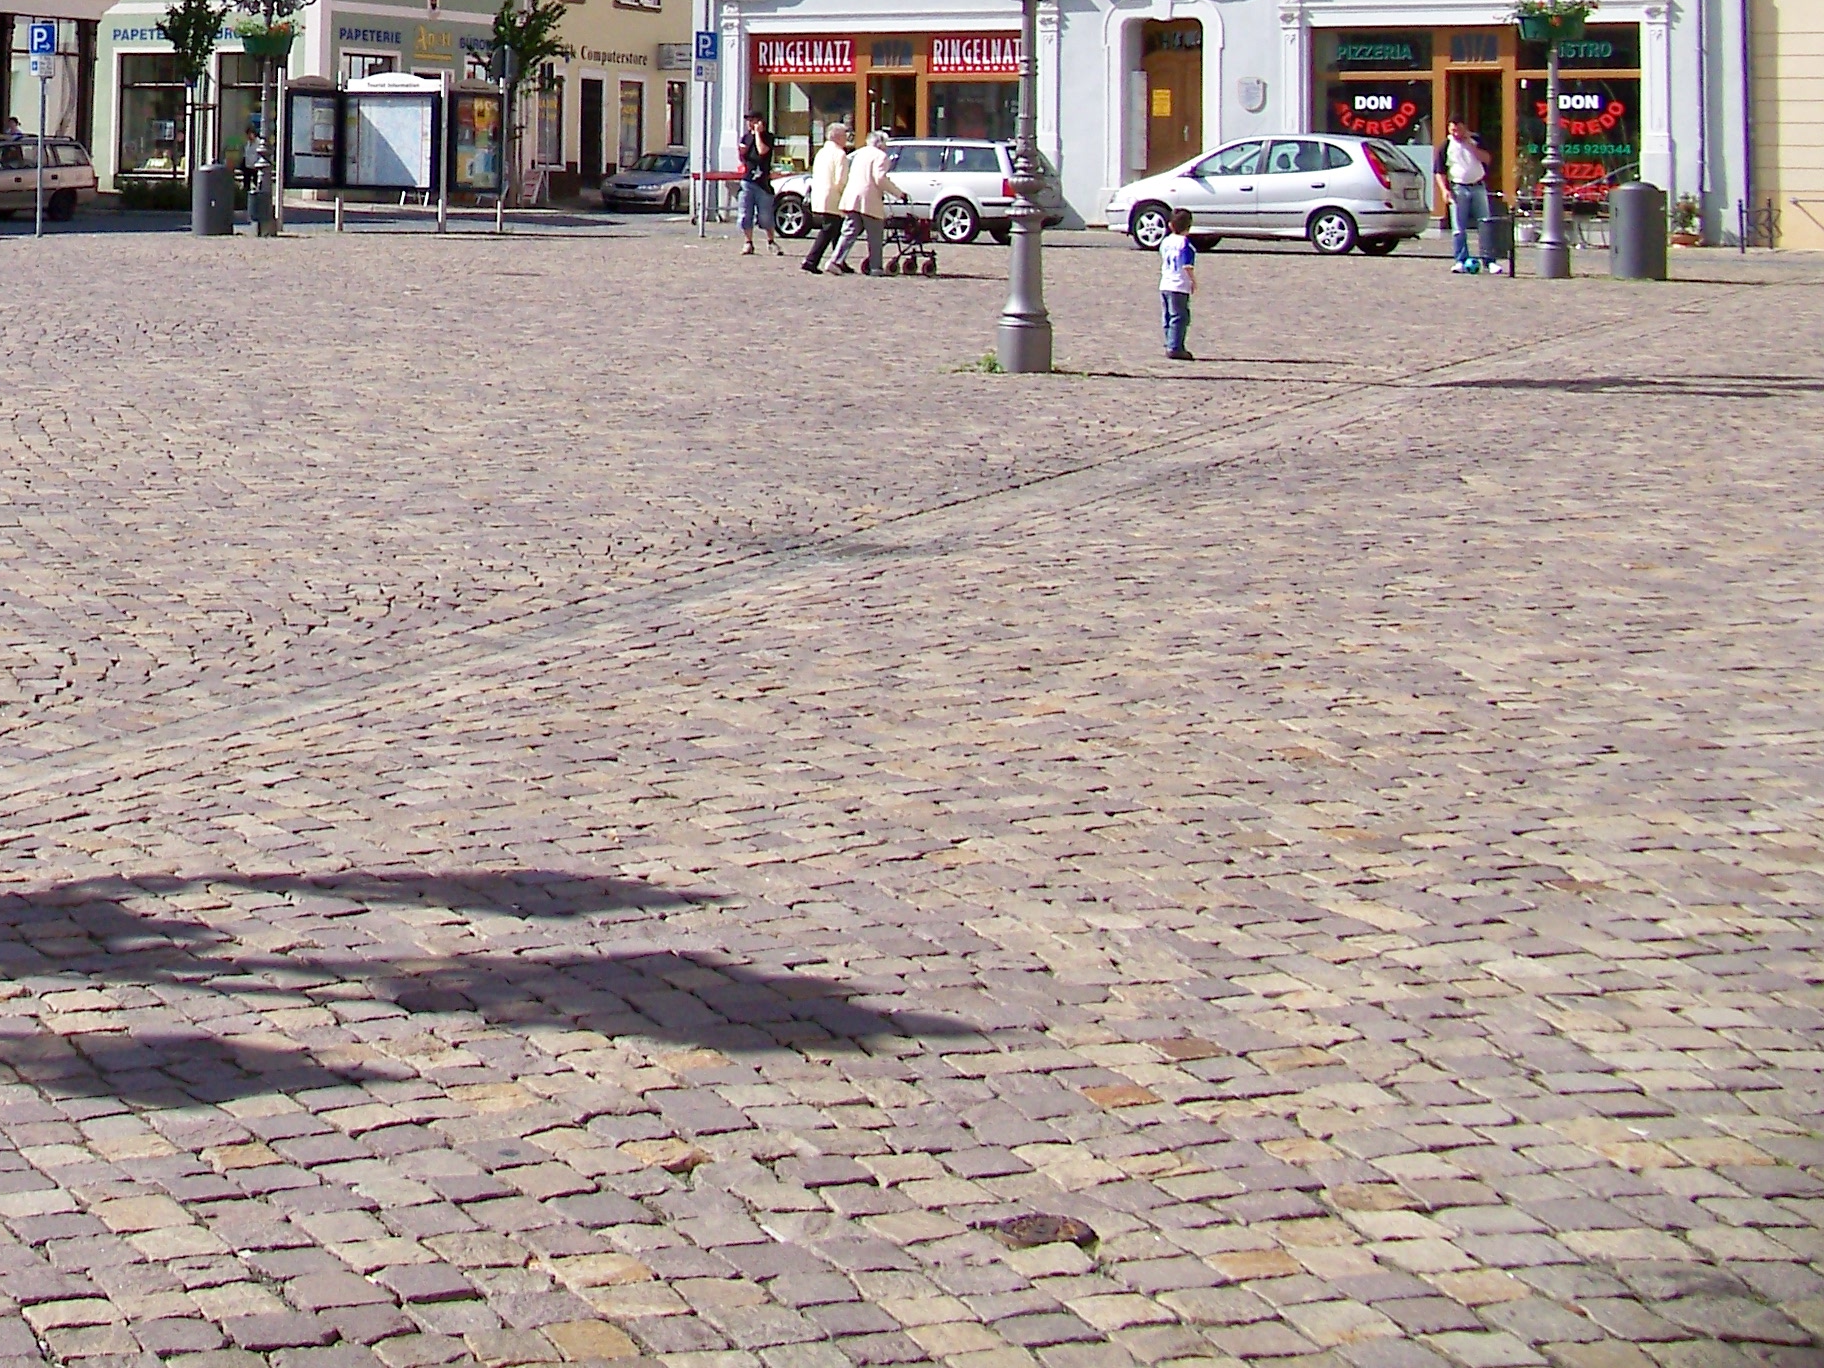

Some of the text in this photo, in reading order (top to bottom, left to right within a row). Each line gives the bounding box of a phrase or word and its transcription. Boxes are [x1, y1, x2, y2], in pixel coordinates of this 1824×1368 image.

[33, 27, 47, 51] P
[112, 28, 165, 40] PAPETE
[339, 27, 402, 44] PAPETERIE
[698, 34, 712, 57] P
[758, 40, 852, 66] RINGELNATZ
[933, 38, 1021, 65] RINGELNAT
[1336, 43, 1413, 61] PIZZERIA
[1558, 42, 1613, 59] ISTRO
[580, 45, 648, 66] Computerstore
[1354, 96, 1392, 110] DON
[1558, 95, 1599, 109] DON
[1336, 101, 1416, 135] ALFREDO
[1584, 144, 1631, 154] 929344
